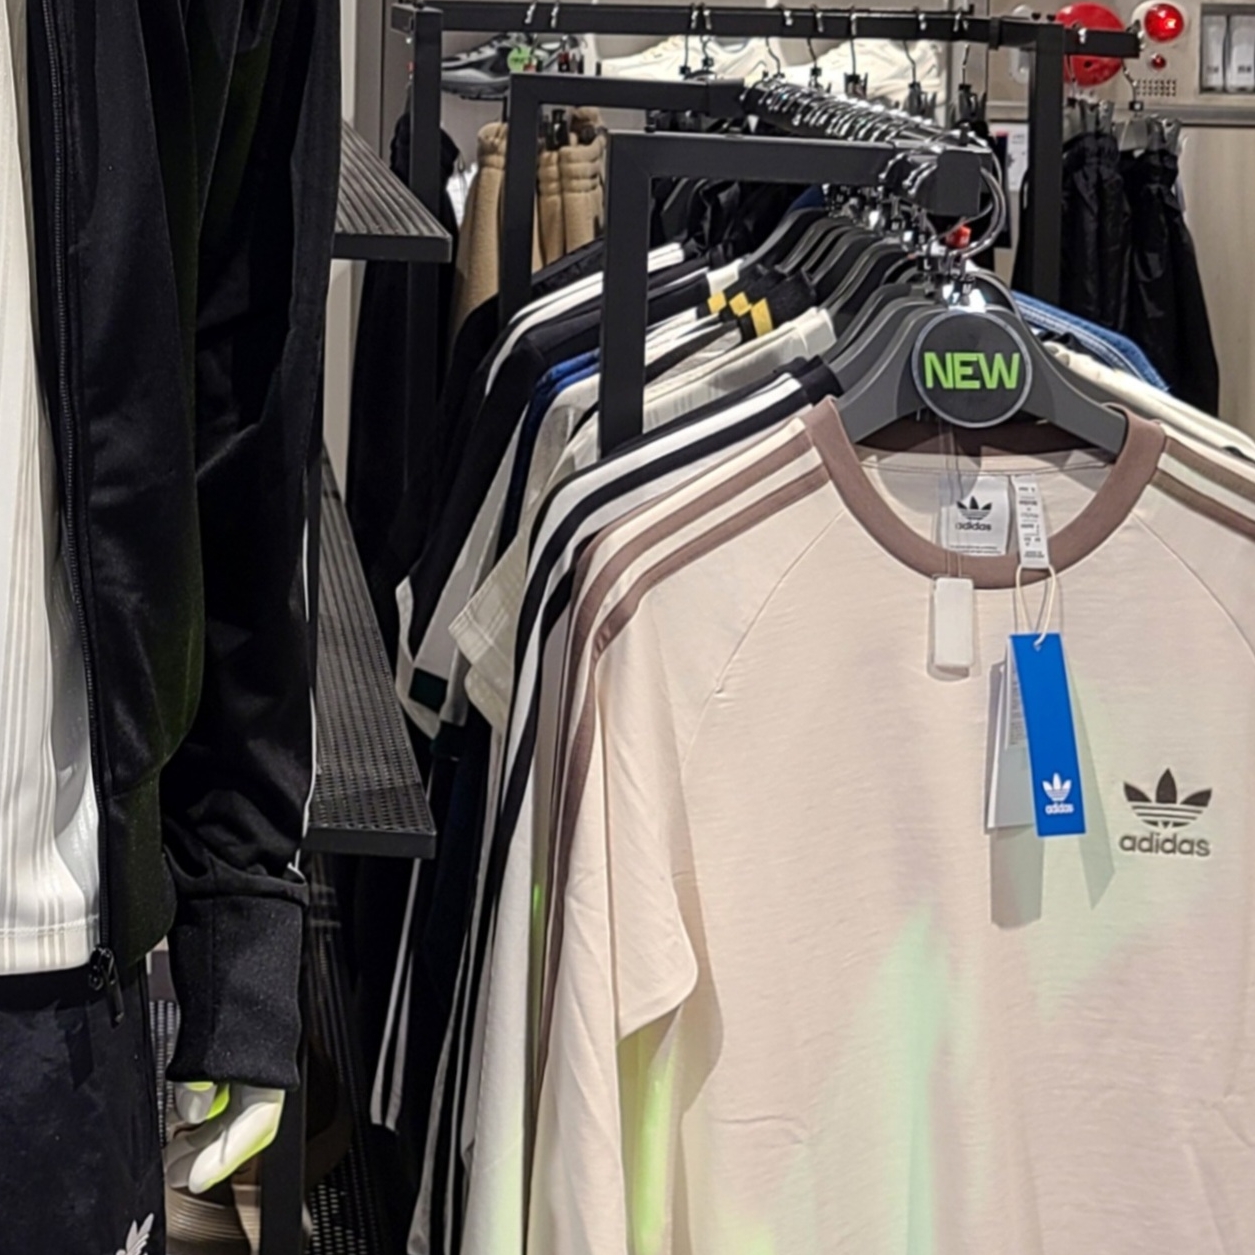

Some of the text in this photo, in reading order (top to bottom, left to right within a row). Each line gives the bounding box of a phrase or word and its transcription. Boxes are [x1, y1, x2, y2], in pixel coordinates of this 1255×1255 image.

[923, 351, 1021, 390] NEW
[955, 522, 992, 532] adidas
[1119, 831, 1211, 857] adidas
